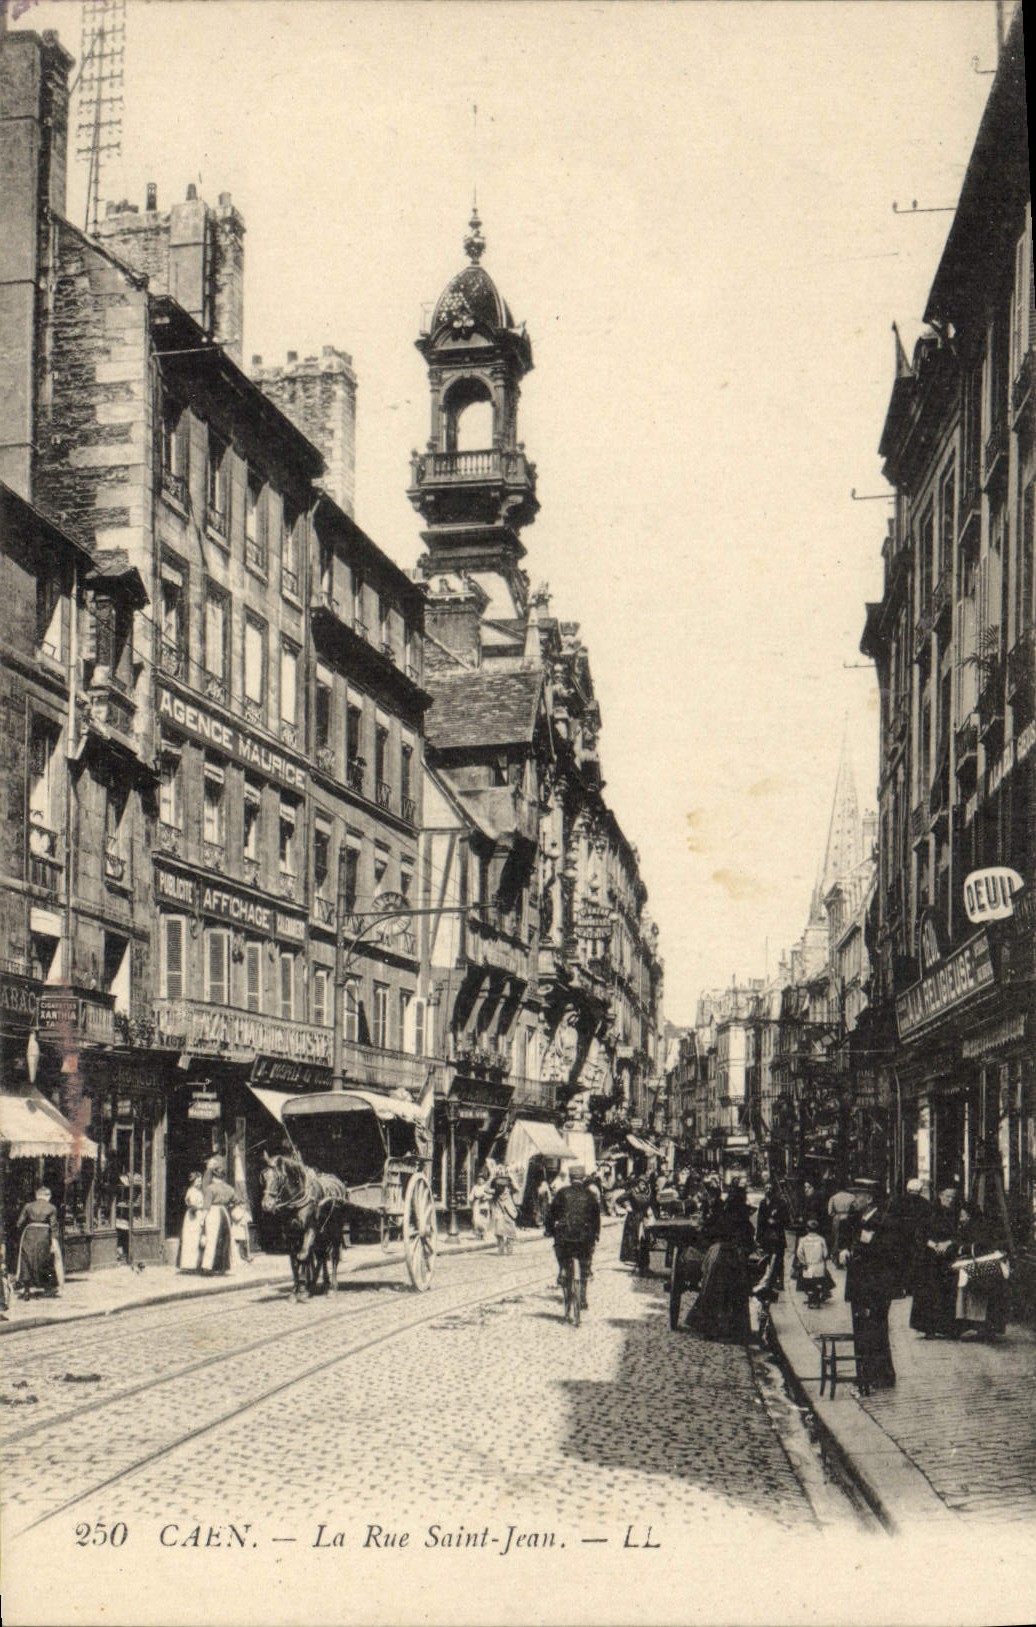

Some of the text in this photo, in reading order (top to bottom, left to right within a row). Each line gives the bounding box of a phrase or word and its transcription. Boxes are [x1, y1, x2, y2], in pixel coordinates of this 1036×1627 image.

[160, 690, 306, 790] AGENCE MAURICE
[203, 888, 271, 929] AFFICHAGE
